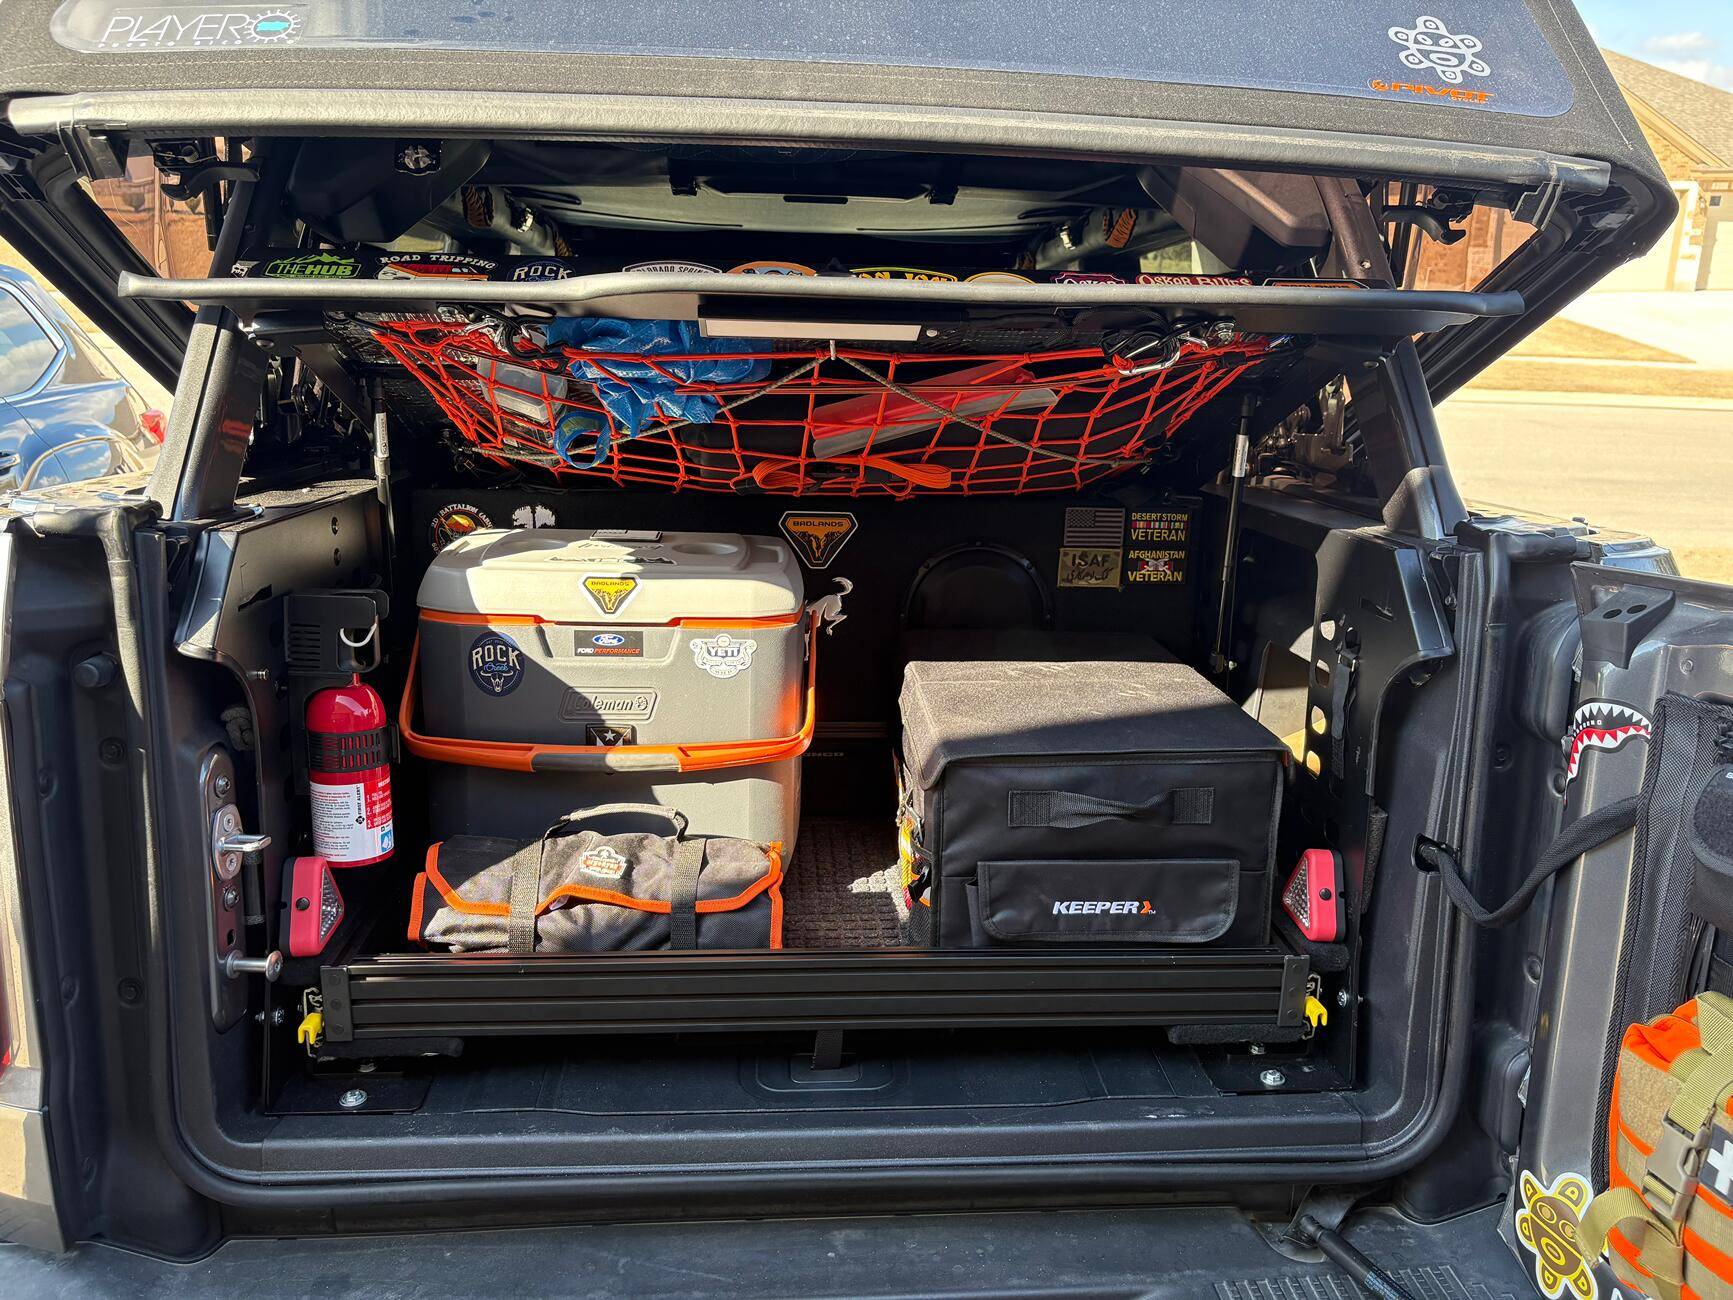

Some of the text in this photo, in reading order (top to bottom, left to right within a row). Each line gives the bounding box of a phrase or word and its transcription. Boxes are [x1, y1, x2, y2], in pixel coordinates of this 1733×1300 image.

[379, 253, 497, 270] ROAD TRIPPING
[512, 265, 573, 282] ROCK
[439, 504, 478, 516] BATTALION
[1131, 512, 1188, 522] DESERT STORM
[792, 520, 845, 528] BADLANDS
[1131, 528, 1186, 542] VETERAN
[1071, 553, 1111, 567] ISAF
[1128, 550, 1186, 560] AFGHANISTAN
[1127, 570, 1183, 582] VETERAN
[472, 644, 521, 671] ROCK
[1052, 900, 1140, 915] KEEPER
